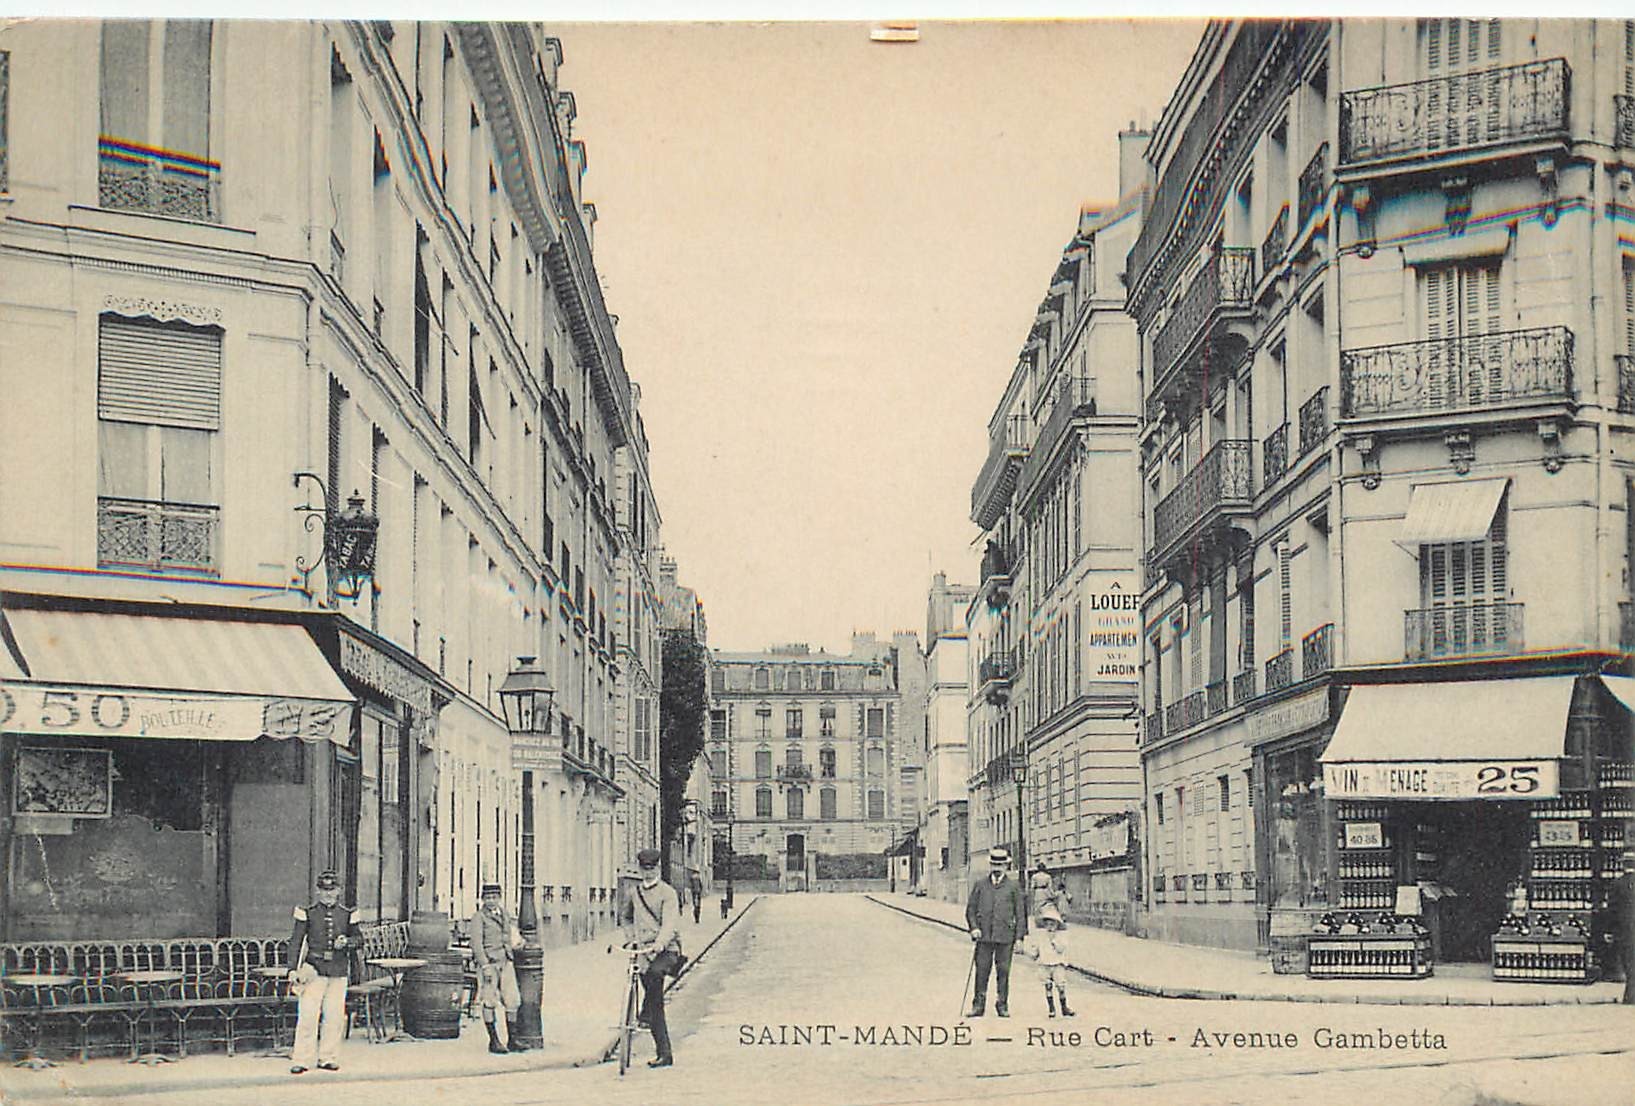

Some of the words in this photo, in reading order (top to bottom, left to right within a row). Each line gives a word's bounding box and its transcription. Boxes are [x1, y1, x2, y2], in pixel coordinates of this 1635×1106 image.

[339, 533, 357, 569] TABAC
[1097, 665, 1135, 675] JARDIN
[1330, 768, 1358, 793] VIN
[1477, 766, 1540, 794] 25
